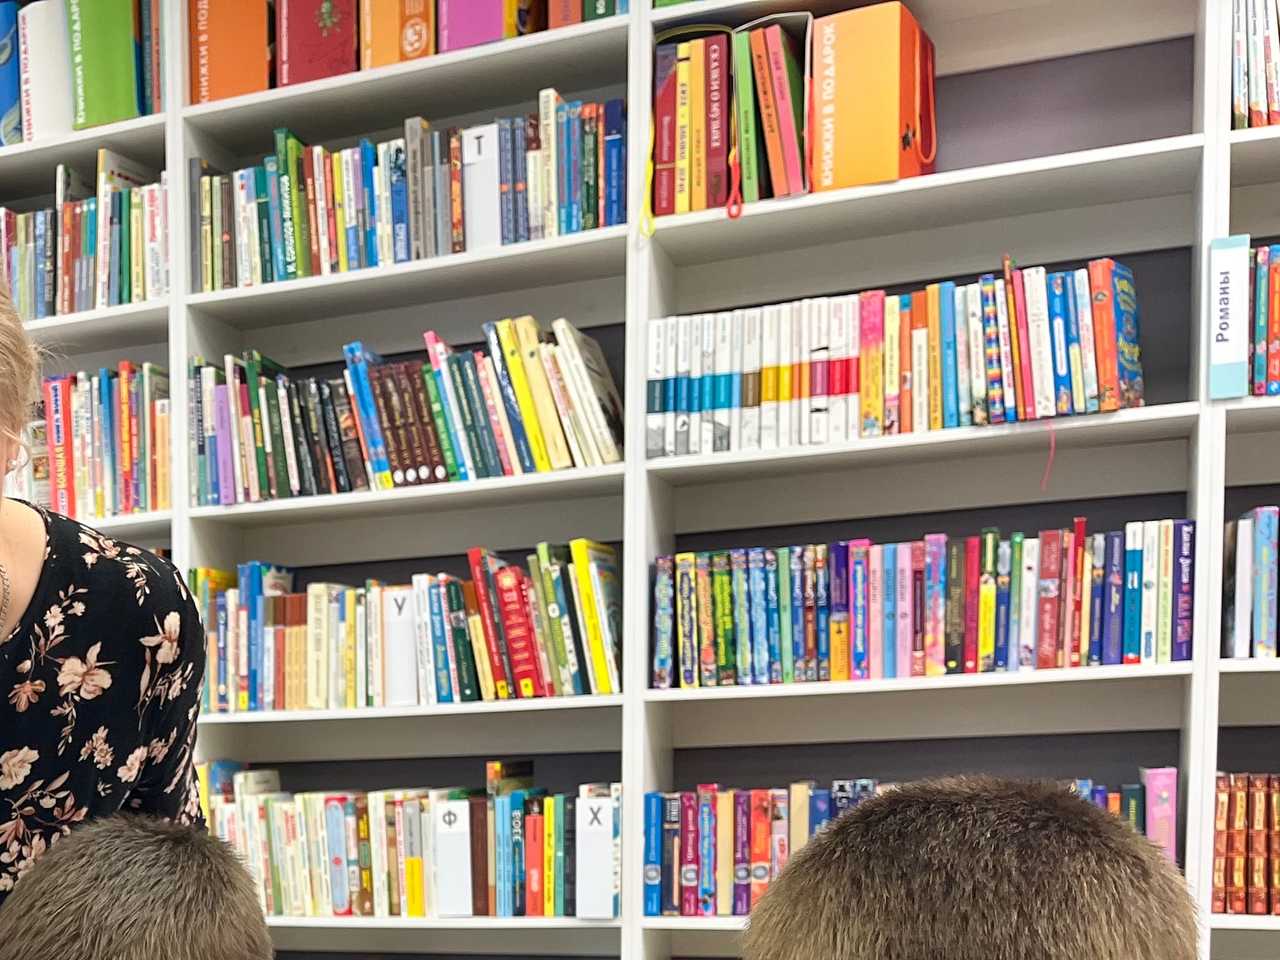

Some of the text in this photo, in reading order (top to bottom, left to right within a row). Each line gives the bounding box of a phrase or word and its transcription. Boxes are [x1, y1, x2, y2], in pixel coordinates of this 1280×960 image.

[71, 0, 81, 52] ПОДАР
[75, 66, 86, 124] КНИЖКИ
[820, 22, 836, 187] КНИЖКИ В ПОДАРОК
[1215, 270, 1232, 344] Романы
[441, 808, 458, 829] Ф
